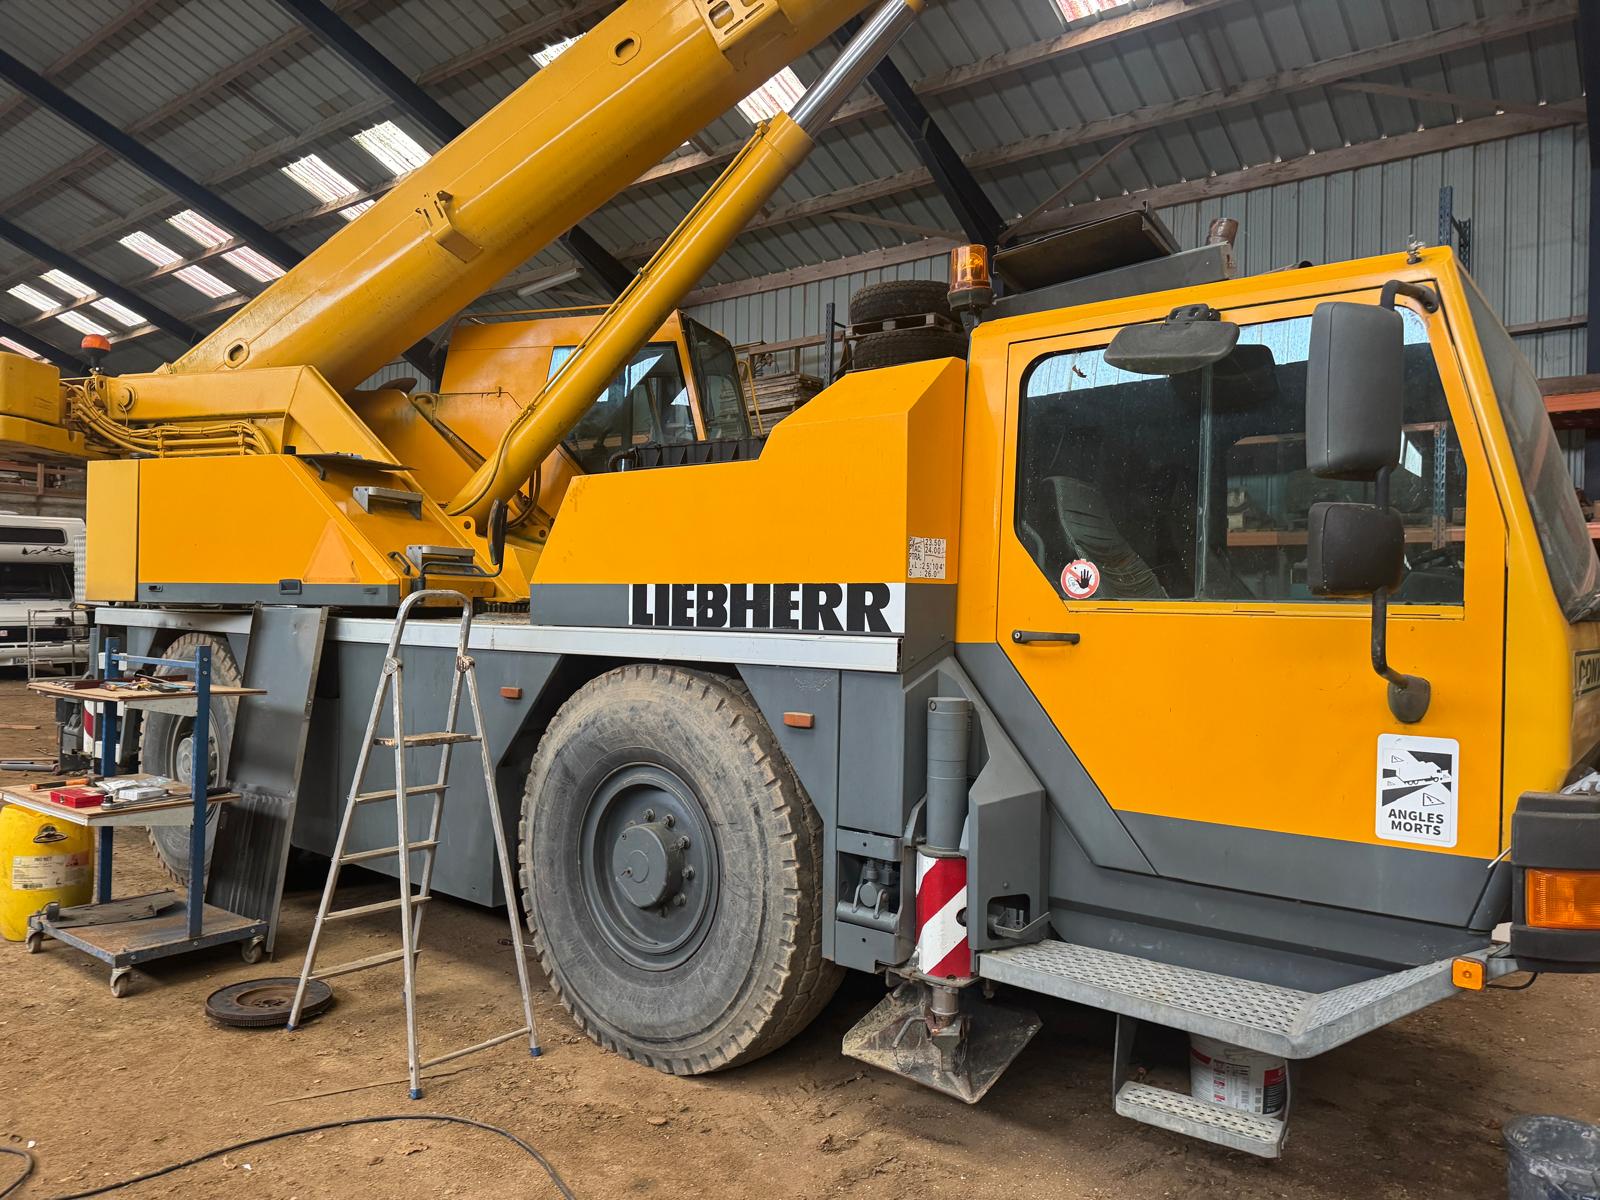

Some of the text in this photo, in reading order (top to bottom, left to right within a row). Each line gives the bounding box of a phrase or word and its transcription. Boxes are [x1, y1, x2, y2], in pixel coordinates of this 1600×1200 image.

[632, 583, 892, 632] LIEBHERR
[1388, 808, 1444, 824] ANGLES
[1391, 820, 1441, 836] MORTS
